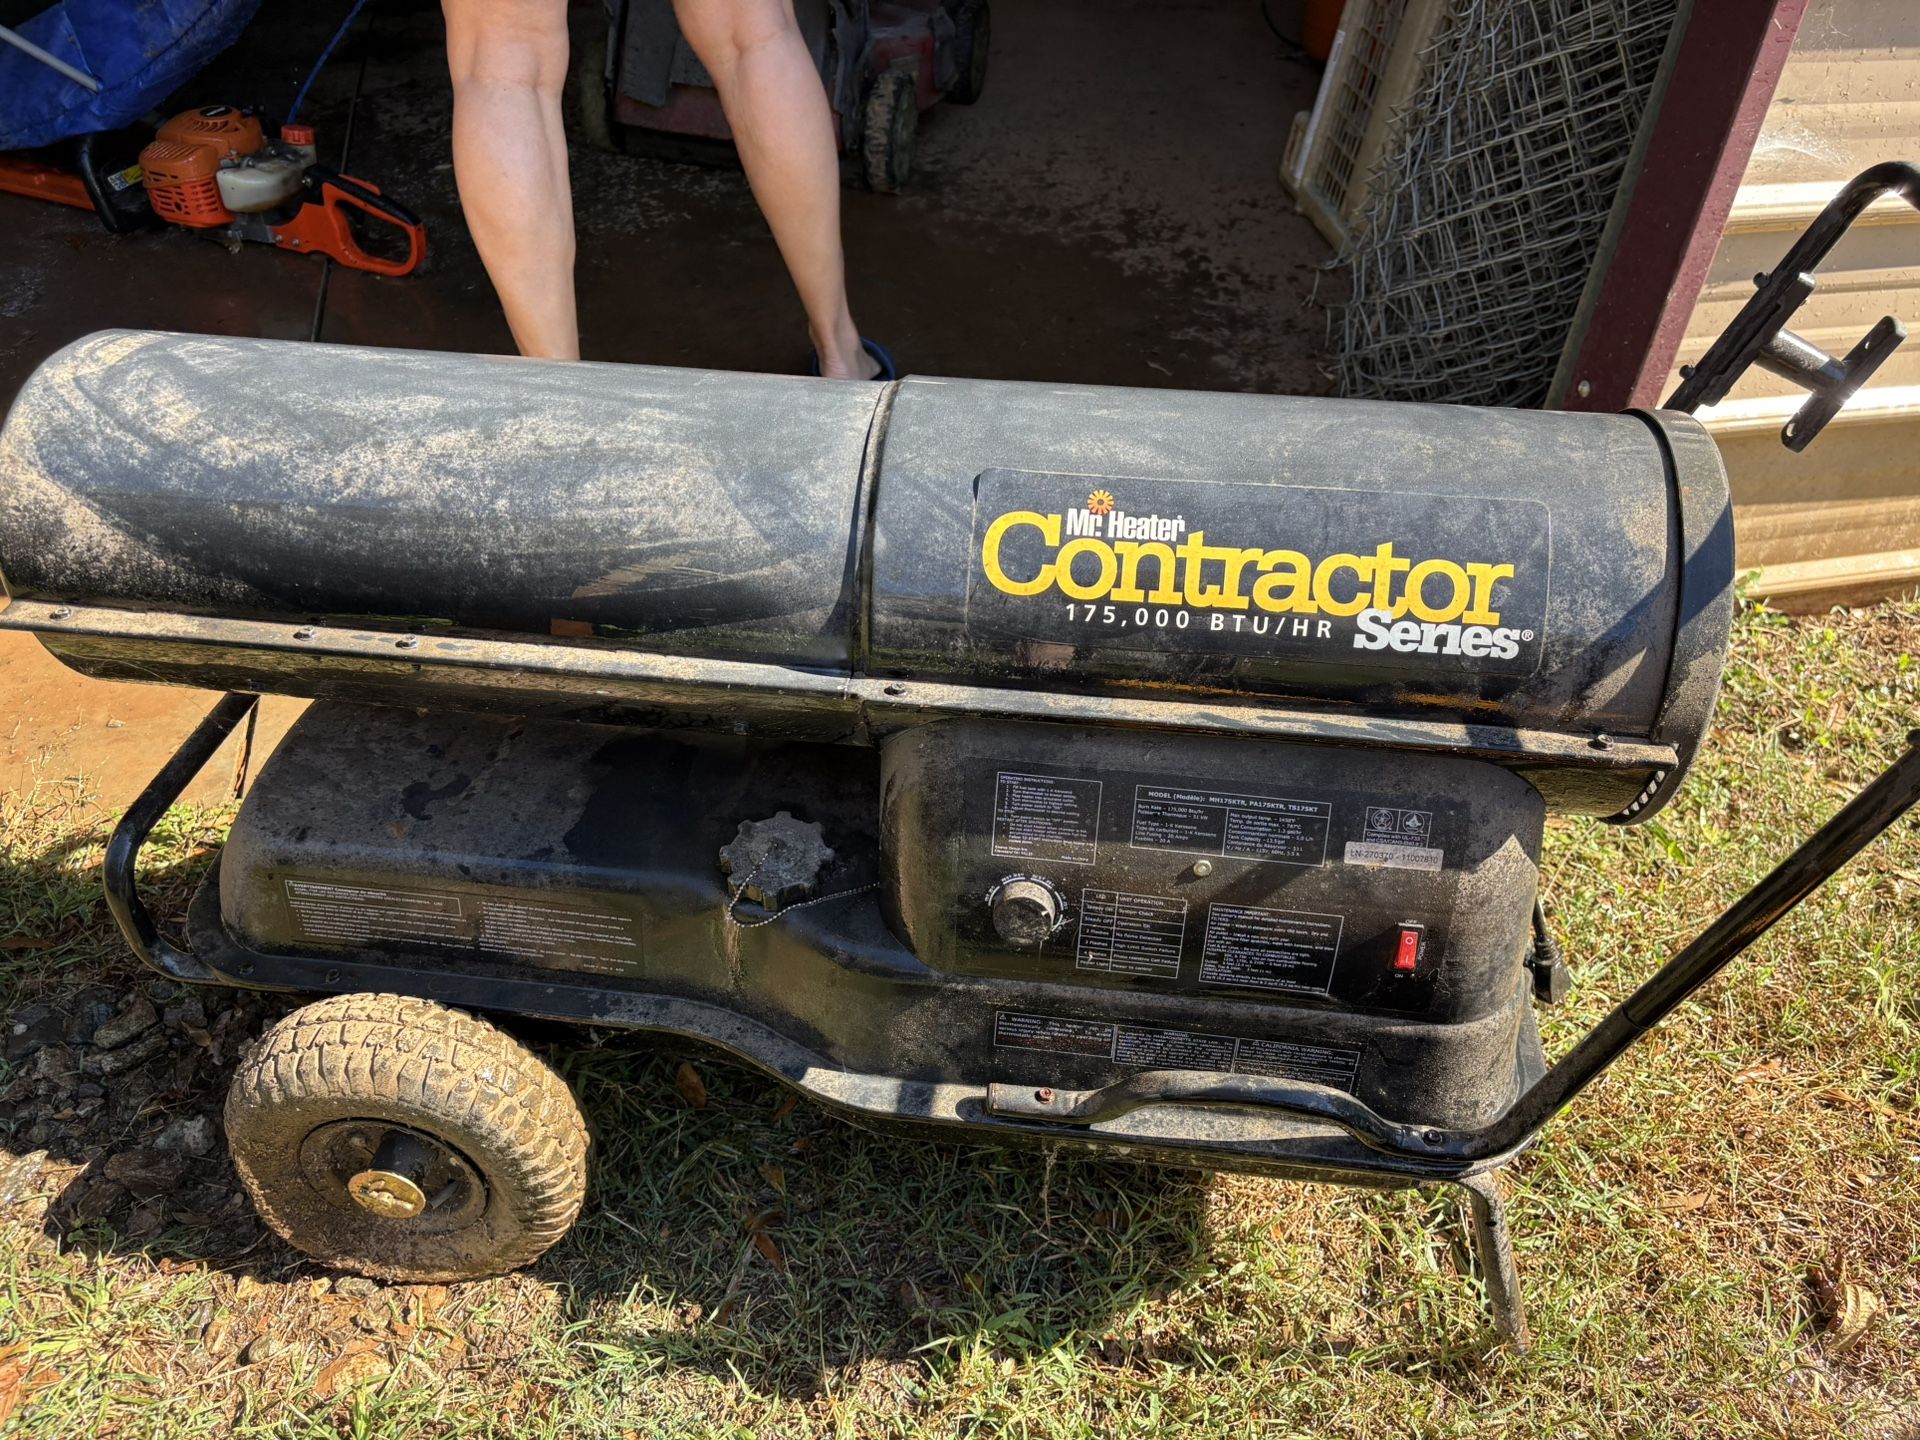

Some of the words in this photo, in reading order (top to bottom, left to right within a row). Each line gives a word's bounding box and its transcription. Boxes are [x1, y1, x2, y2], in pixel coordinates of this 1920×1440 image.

[1066, 508, 1102, 537] Mr.
[1107, 511, 1185, 542] Heater
[981, 511, 1514, 626] Contractor
[1065, 603, 1190, 629] 175,000
[1210, 612, 1332, 639] BTU/HR
[1261, 1042, 1299, 1051] CALIFORNIA
